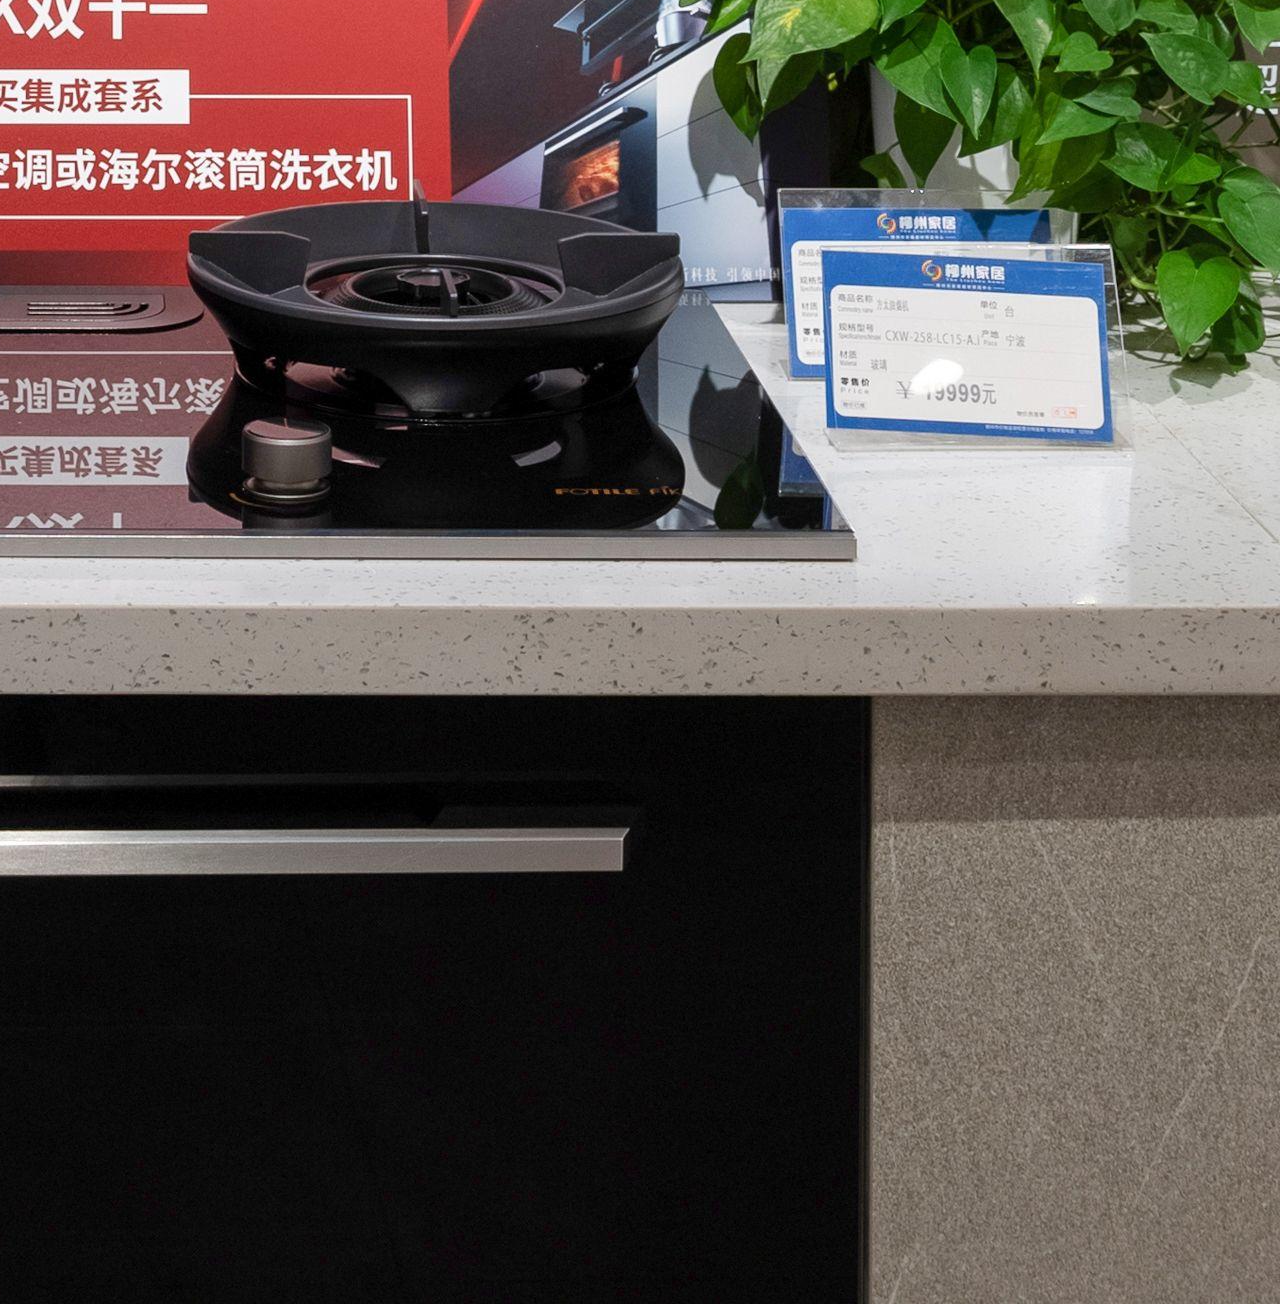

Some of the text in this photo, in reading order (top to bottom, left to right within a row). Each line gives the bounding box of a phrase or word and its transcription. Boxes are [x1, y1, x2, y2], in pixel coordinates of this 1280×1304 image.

[944, 263, 1006, 281] 柳州家居
[838, 293, 873, 303] 商品名称
[980, 300, 998, 309] 单位
[1004, 305, 1015, 318] 台
[1005, 335, 1026, 348] 宁波
[870, 359, 888, 371] 玻璃
[840, 377, 870, 387] 零售价
